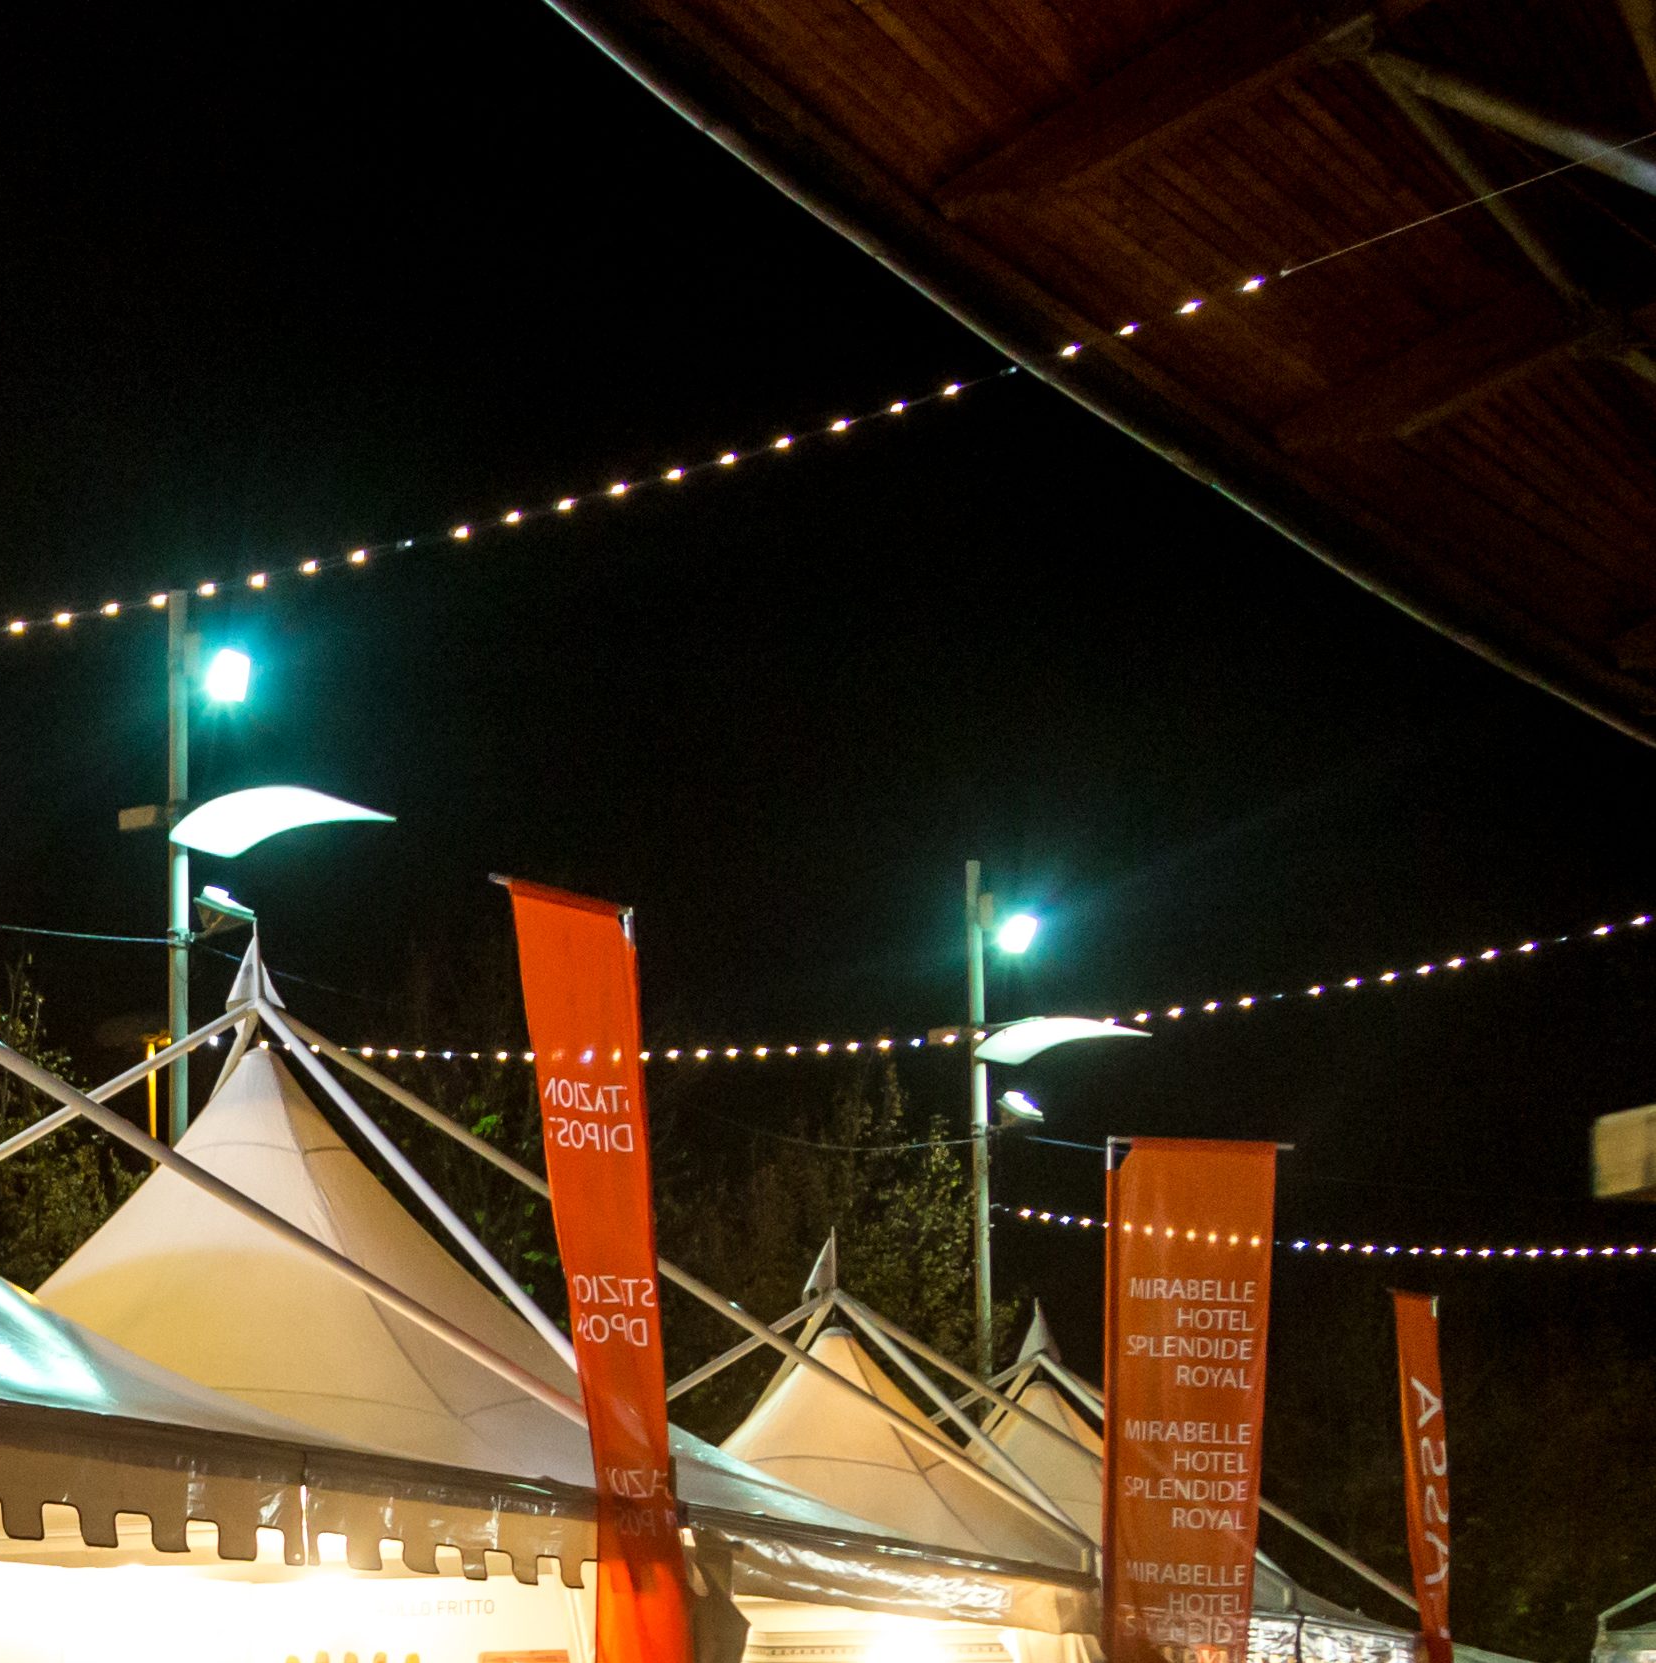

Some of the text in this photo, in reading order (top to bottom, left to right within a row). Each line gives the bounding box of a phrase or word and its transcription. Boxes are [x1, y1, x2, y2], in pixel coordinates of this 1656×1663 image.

[1129, 1277, 1257, 1303] MIRABELLE
[1176, 1307, 1255, 1332] HOTEL
[1126, 1334, 1253, 1361] SPLENDIDE
[1175, 1365, 1252, 1390] ROYAL
[1124, 1419, 1252, 1446] MIRABELLE
[1173, 1450, 1249, 1474] HOTEL
[1123, 1475, 1249, 1502] SPLENDIDE
[1171, 1506, 1248, 1531] ROYAL
[1125, 1560, 1246, 1588] MIRABELLE
[435, 1599, 496, 1616] FRITTO
[1168, 1593, 1244, 1617] HOTEL
